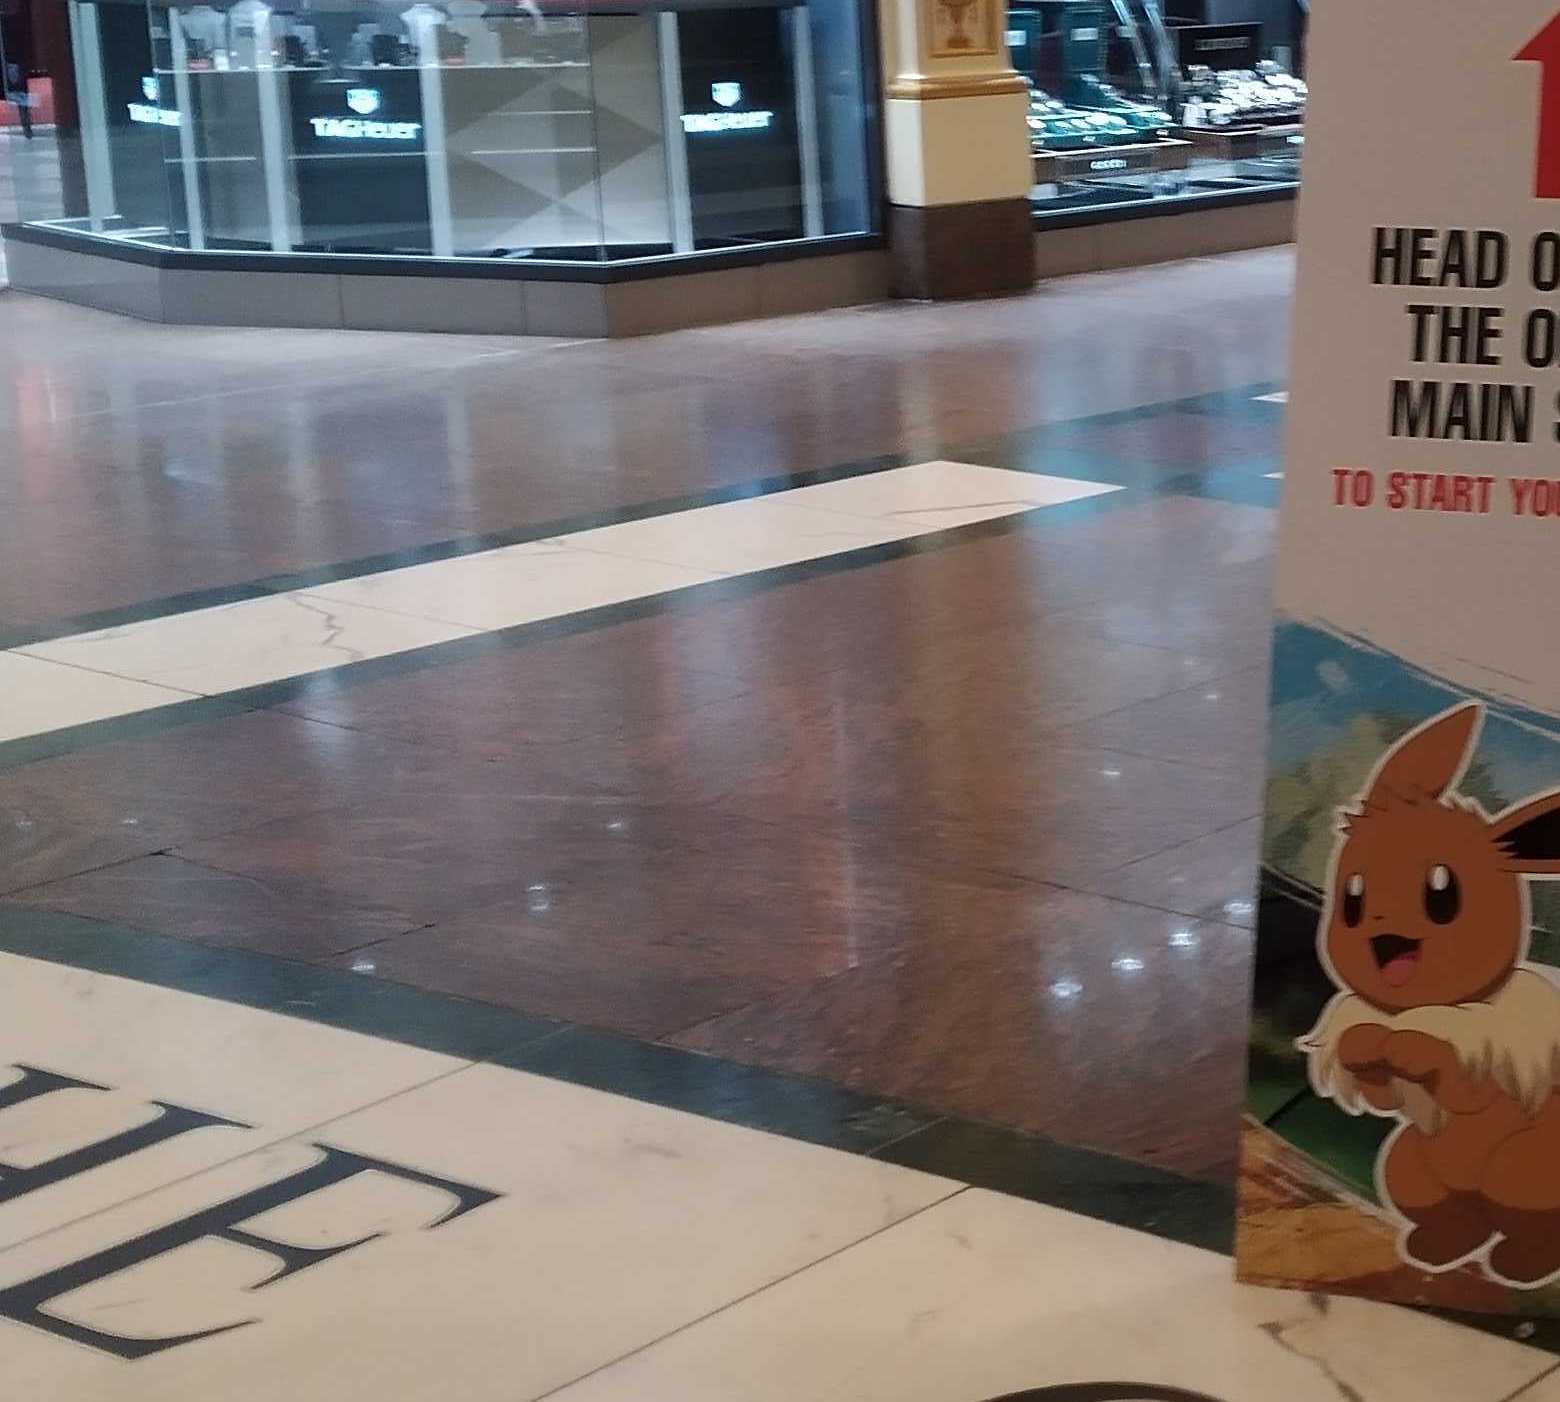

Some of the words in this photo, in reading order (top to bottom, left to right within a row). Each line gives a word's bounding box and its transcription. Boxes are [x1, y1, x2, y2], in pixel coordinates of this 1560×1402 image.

[1371, 227, 1508, 289] HEAD
[1405, 303, 1504, 366] THE
[1388, 379, 1534, 444] MAIN
[1332, 469, 1374, 508] TO
[1387, 471, 1495, 516] START
